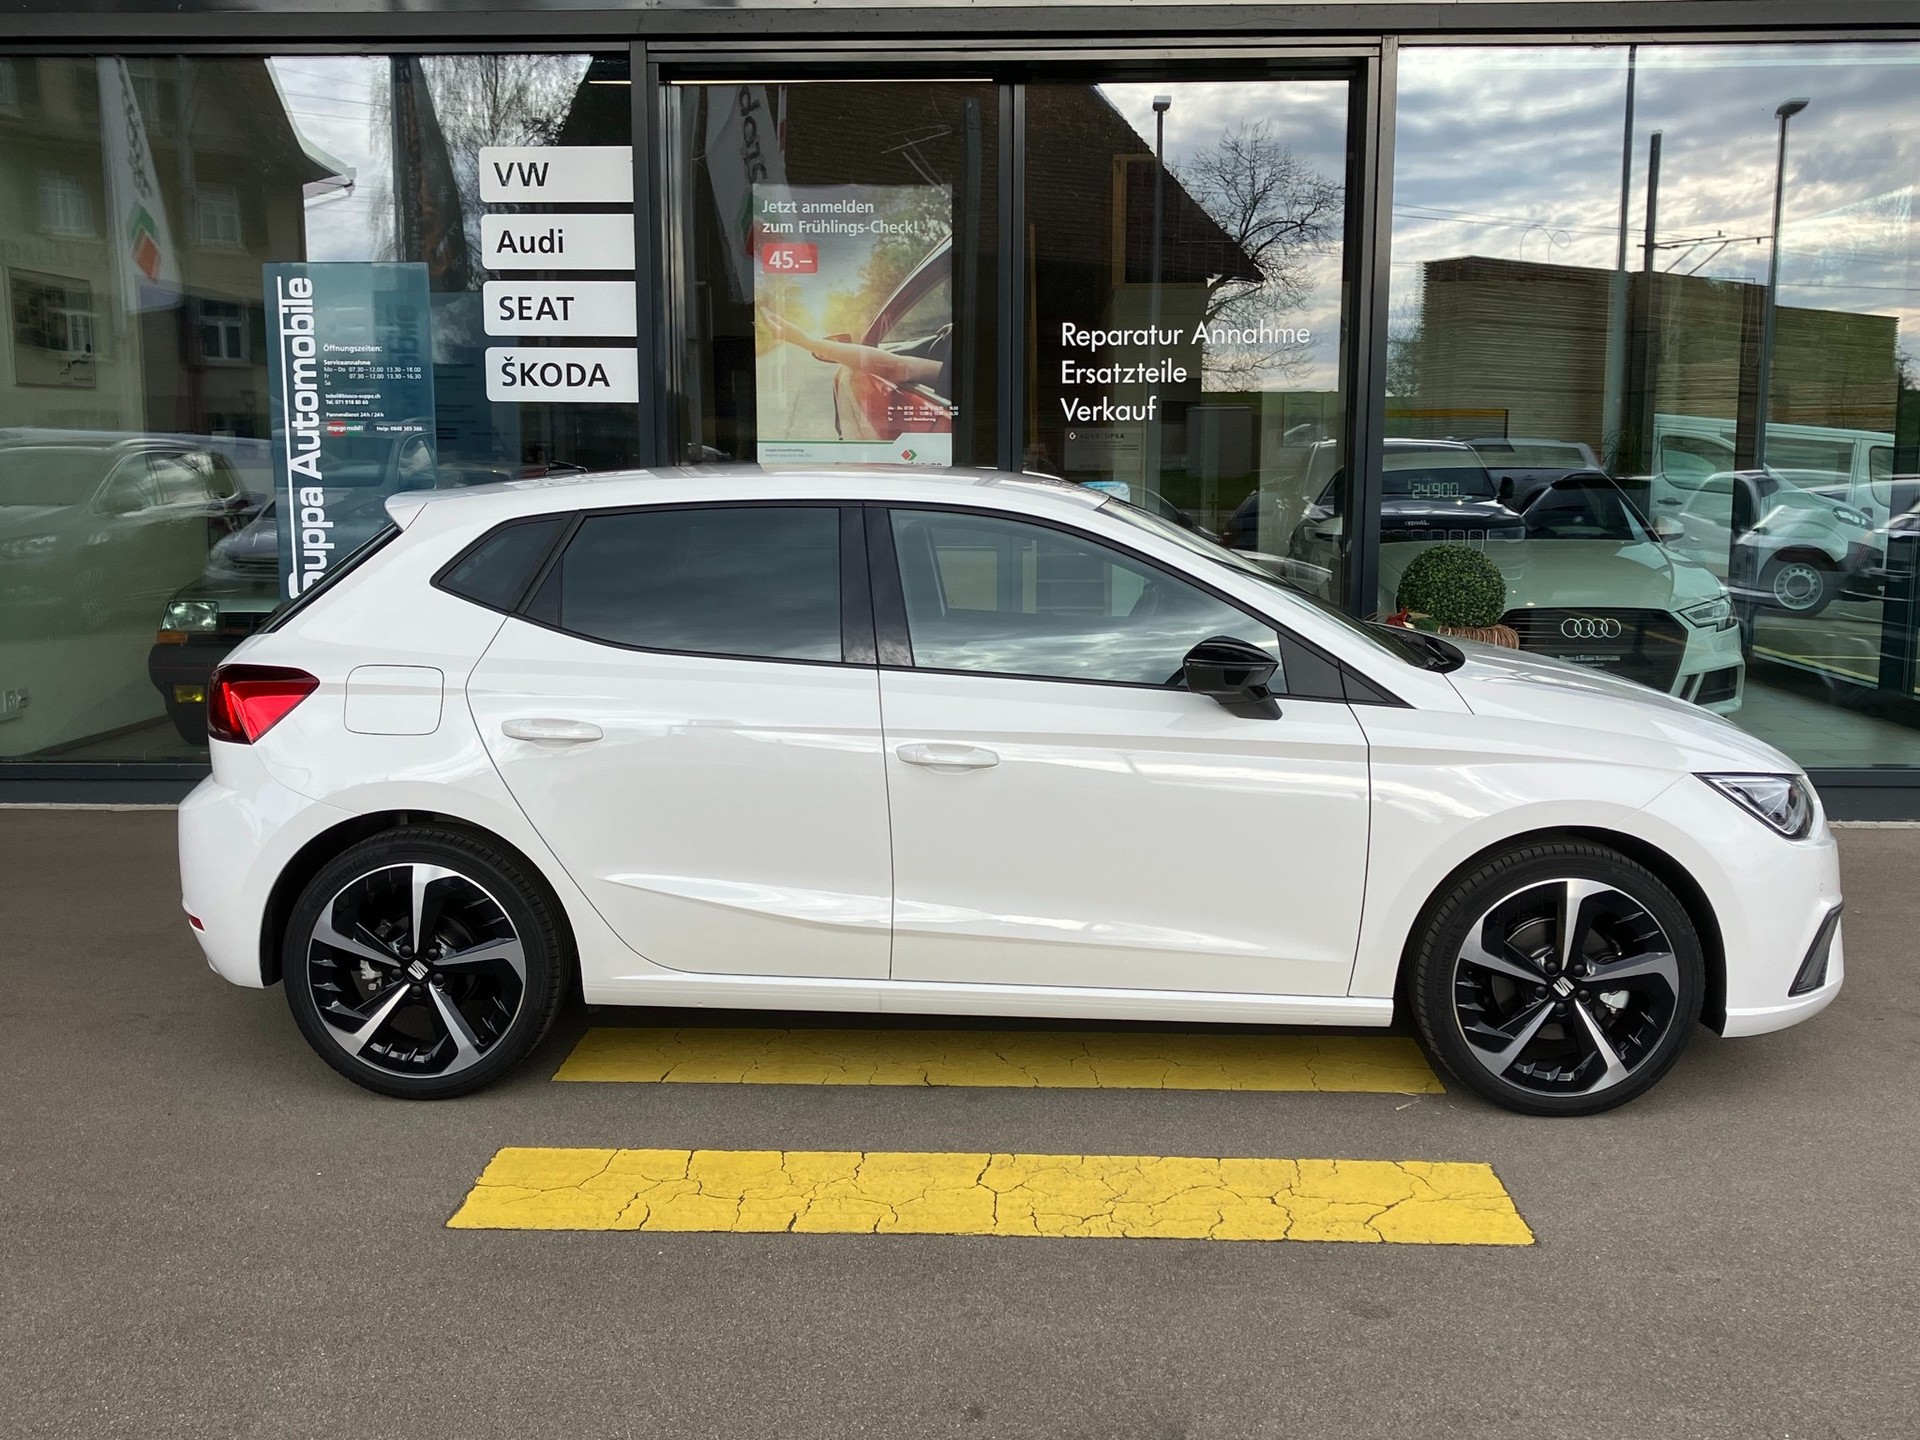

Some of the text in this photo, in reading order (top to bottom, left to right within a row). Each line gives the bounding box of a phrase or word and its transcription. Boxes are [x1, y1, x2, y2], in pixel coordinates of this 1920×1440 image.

[493, 162, 550, 187] VW
[762, 200, 874, 214] Jetzt anmelden
[762, 219, 918, 236] zum Frühlings-Check!
[496, 228, 564, 254] Audi
[499, 296, 575, 321] SEAT
[323, 343, 383, 353] Öffnungszeiten:
[1061, 319, 1311, 352] Reparatur Annahme
[501, 356, 611, 387] ŠKODA
[1061, 358, 1187, 384] Ersatzteile
[1060, 396, 1157, 421] Verkauf
[281, 277, 335, 599] Suppa Automobile
